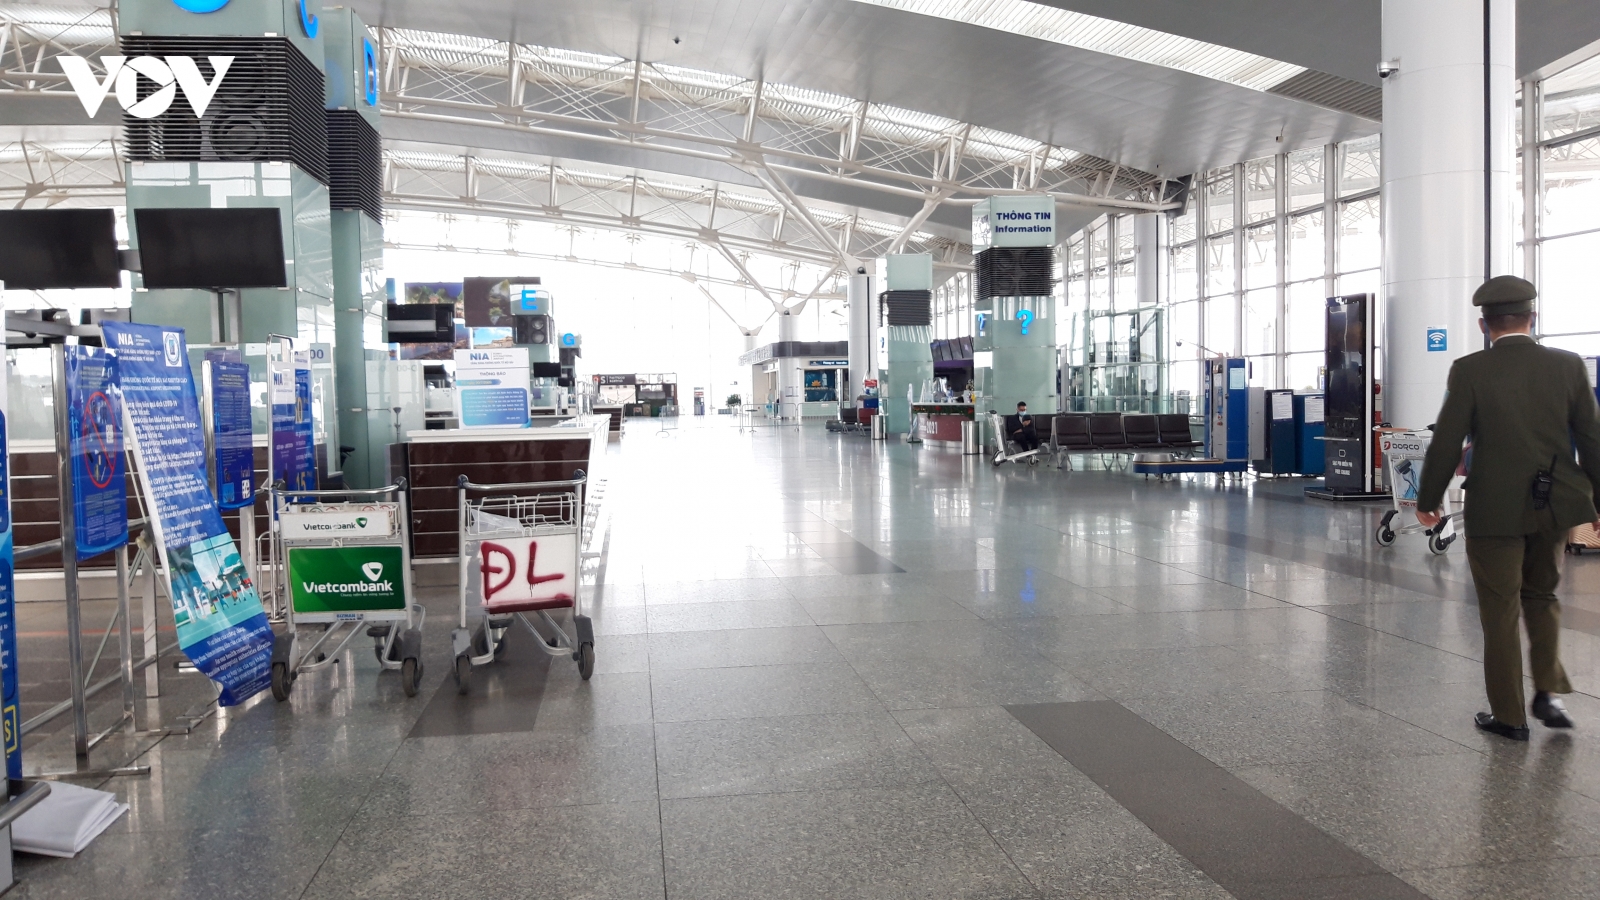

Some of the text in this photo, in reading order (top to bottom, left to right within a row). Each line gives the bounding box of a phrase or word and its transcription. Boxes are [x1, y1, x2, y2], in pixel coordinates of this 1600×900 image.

[363, 37, 377, 107] D
[996, 209, 1051, 220] THÔNG TIN
[995, 224, 1052, 233] Information
[521, 289, 539, 311] E
[117, 332, 134, 346] NIA
[562, 332, 576, 347] G
[469, 352, 490, 361] NIA
[273, 372, 284, 386] NIA
[1392, 443, 1420, 451] DORCO
[303, 580, 394, 594] Vietcombank
